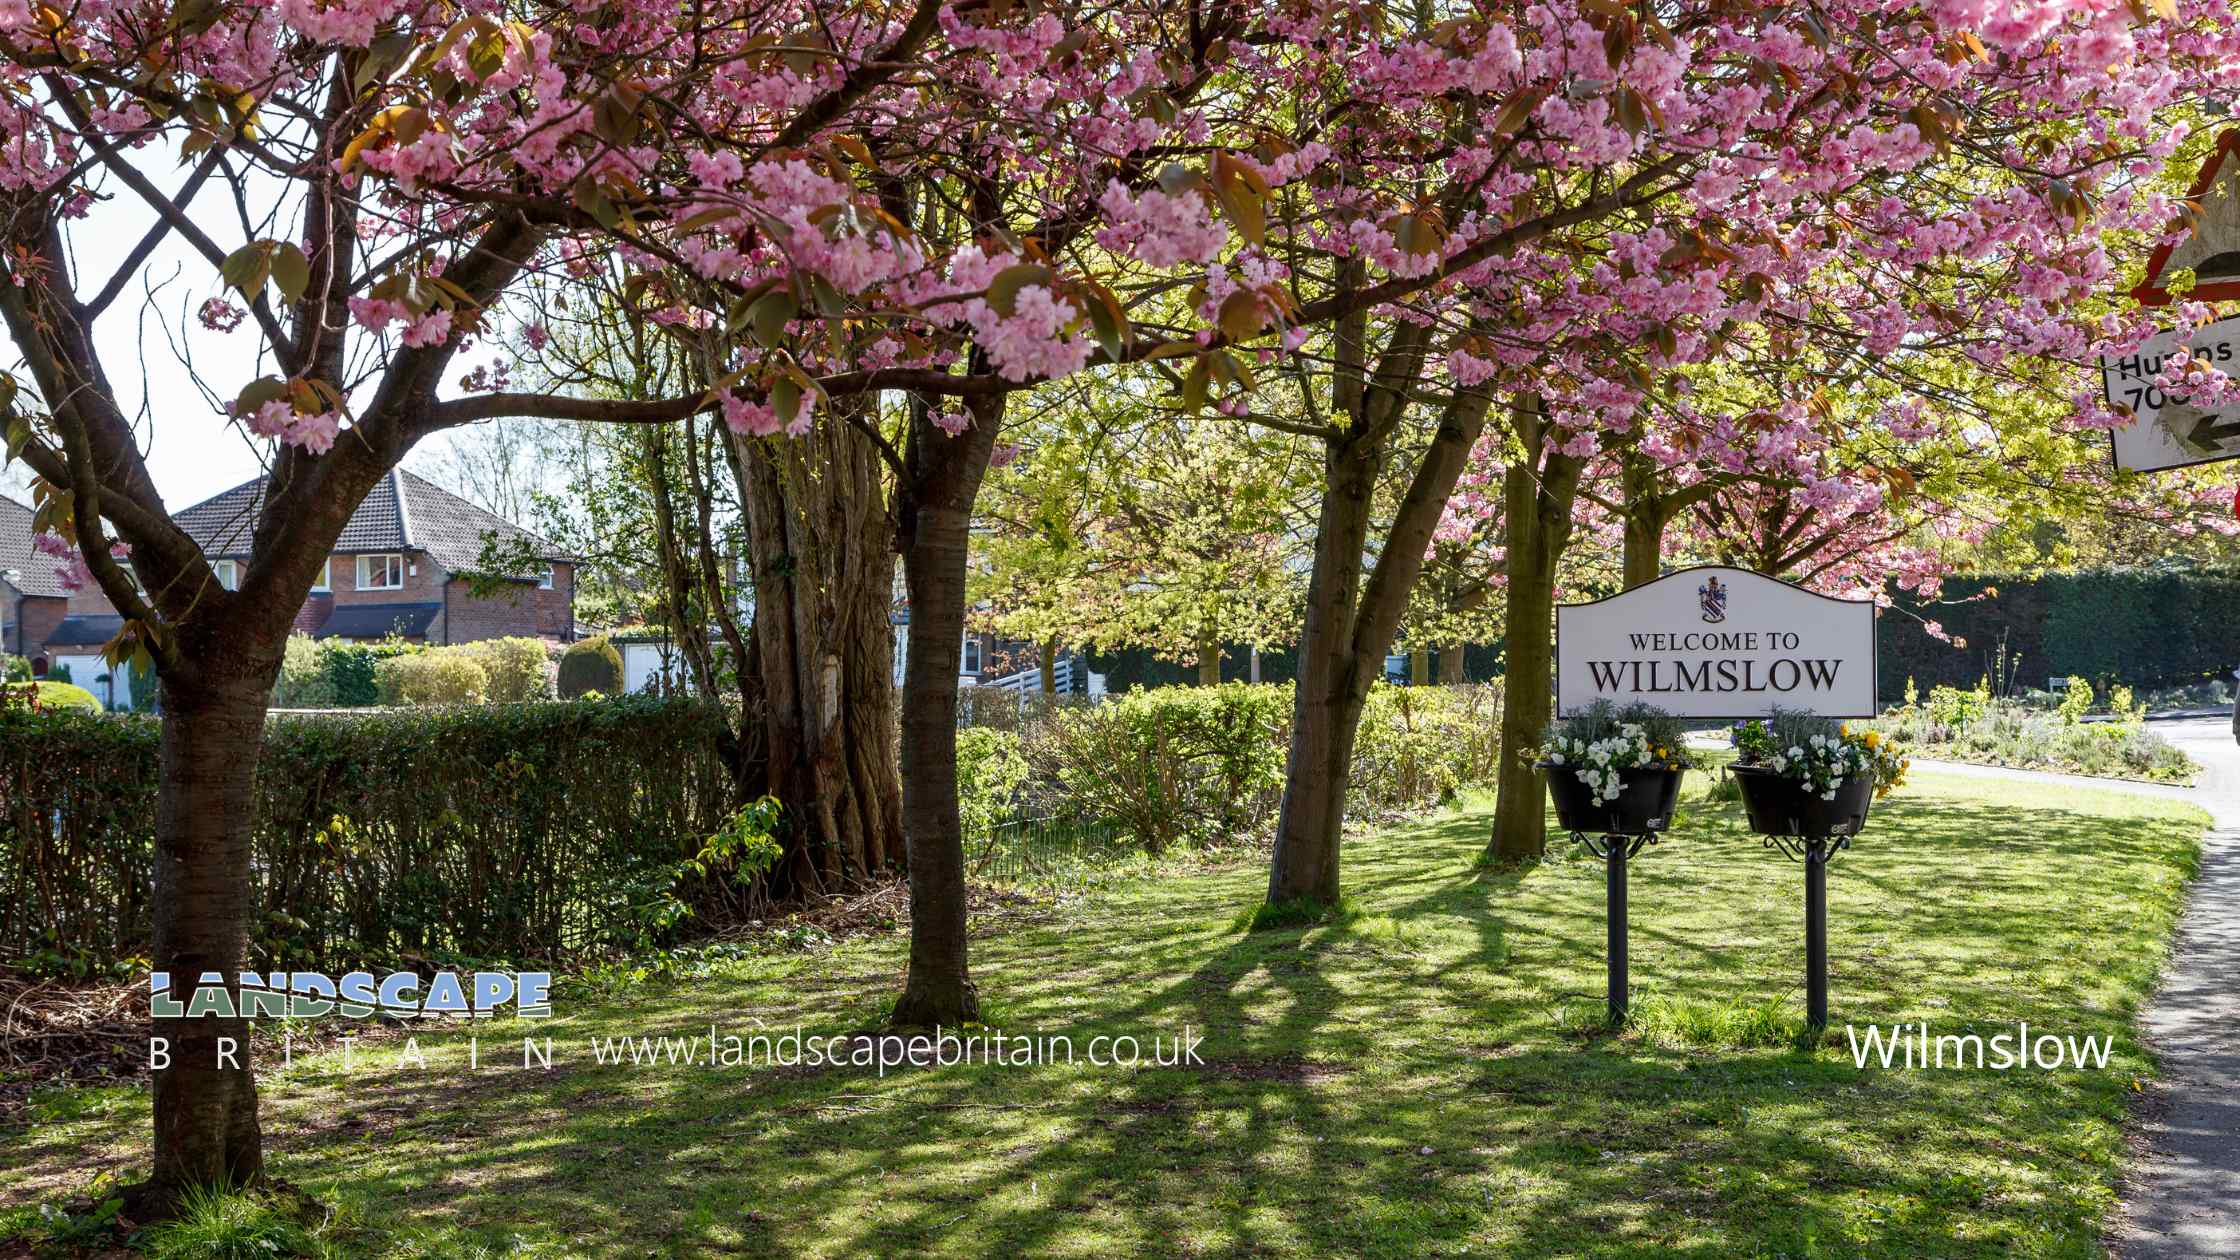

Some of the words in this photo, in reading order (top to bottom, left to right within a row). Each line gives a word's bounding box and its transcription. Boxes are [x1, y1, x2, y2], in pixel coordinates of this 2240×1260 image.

[1629, 632, 1758, 651] WELCOME
[1766, 632, 1800, 651] TO
[1587, 658, 1844, 693] WILMSLOW
